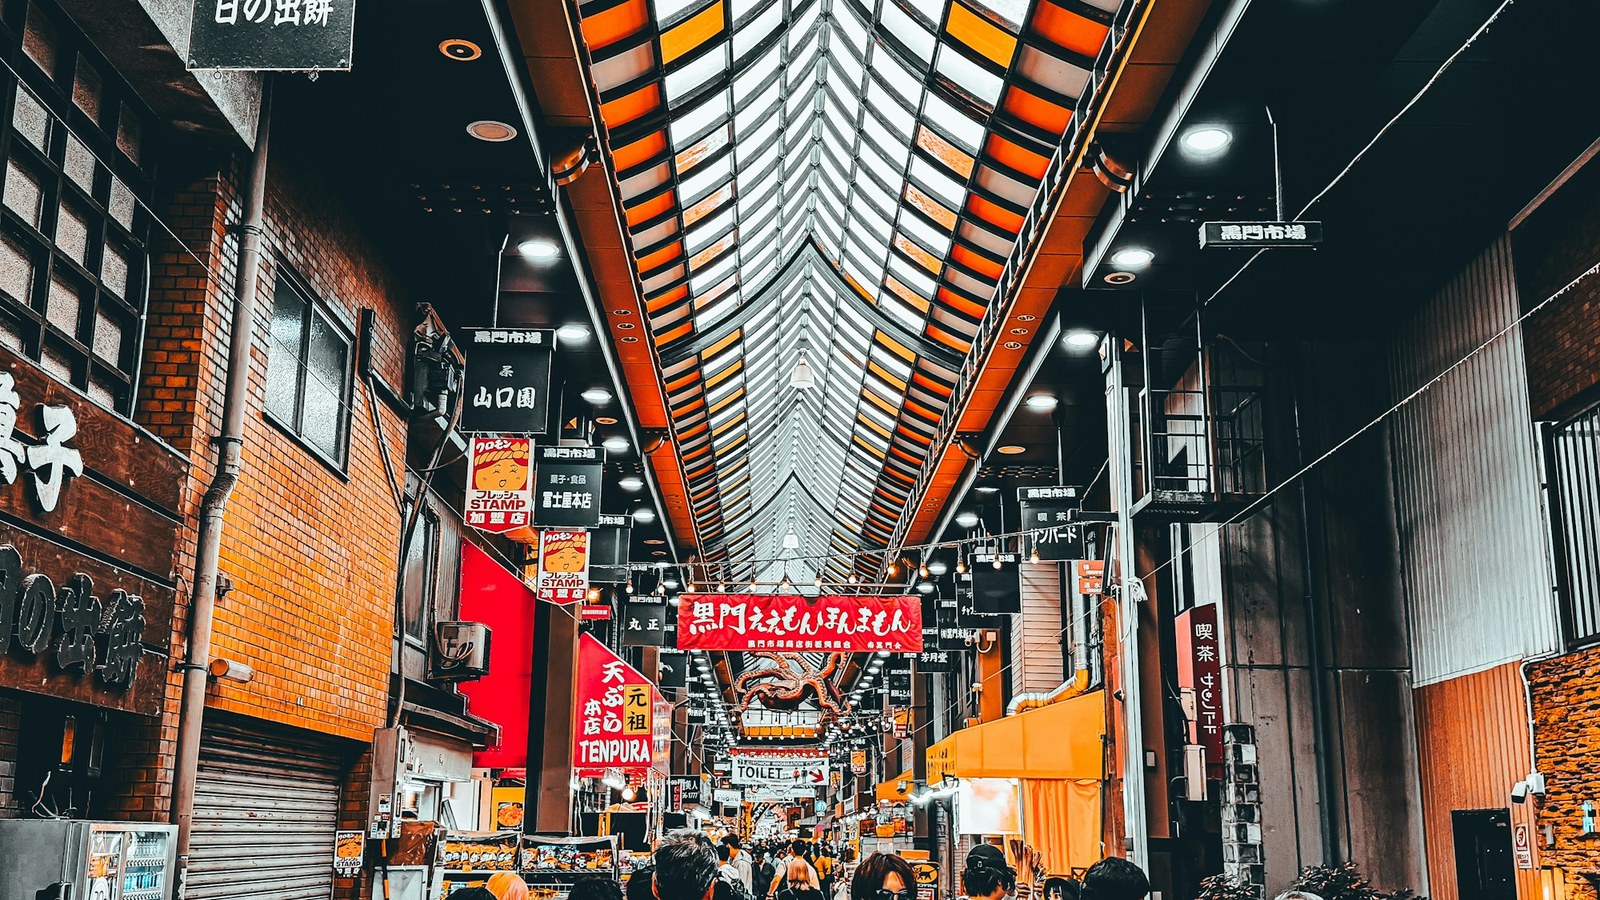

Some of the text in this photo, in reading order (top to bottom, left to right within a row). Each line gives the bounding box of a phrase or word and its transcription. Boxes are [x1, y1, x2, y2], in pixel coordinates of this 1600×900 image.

[1221, 224, 1306, 240] 黒門市場
[474, 330, 542, 344] 黒門市場
[473, 386, 536, 410] 山口園
[475, 440, 512, 453] クロモン
[543, 448, 596, 459] 黒門市場
[550, 474, 587, 485] 菓子・食品
[475, 490, 520, 500] フレッシュ
[1027, 488, 1075, 498] 黒門市場
[470, 499, 526, 510] STAMP
[470, 511, 525, 525] 加盟店
[545, 531, 574, 542] クロモン
[545, 571, 579, 580] フレッシュ
[541, 579, 585, 588] STAMP
[540, 588, 584, 599] 加盟店
[690, 601, 911, 636] 黒門ええもんほんまもん
[1195, 623, 1214, 662] 喫茶
[602, 661, 624, 733] 天ぷら
[627, 688, 647, 731] 元祖
[584, 698, 601, 735] 本店
[579, 739, 650, 763] TENPURA
[738, 766, 783, 779] TOILET
